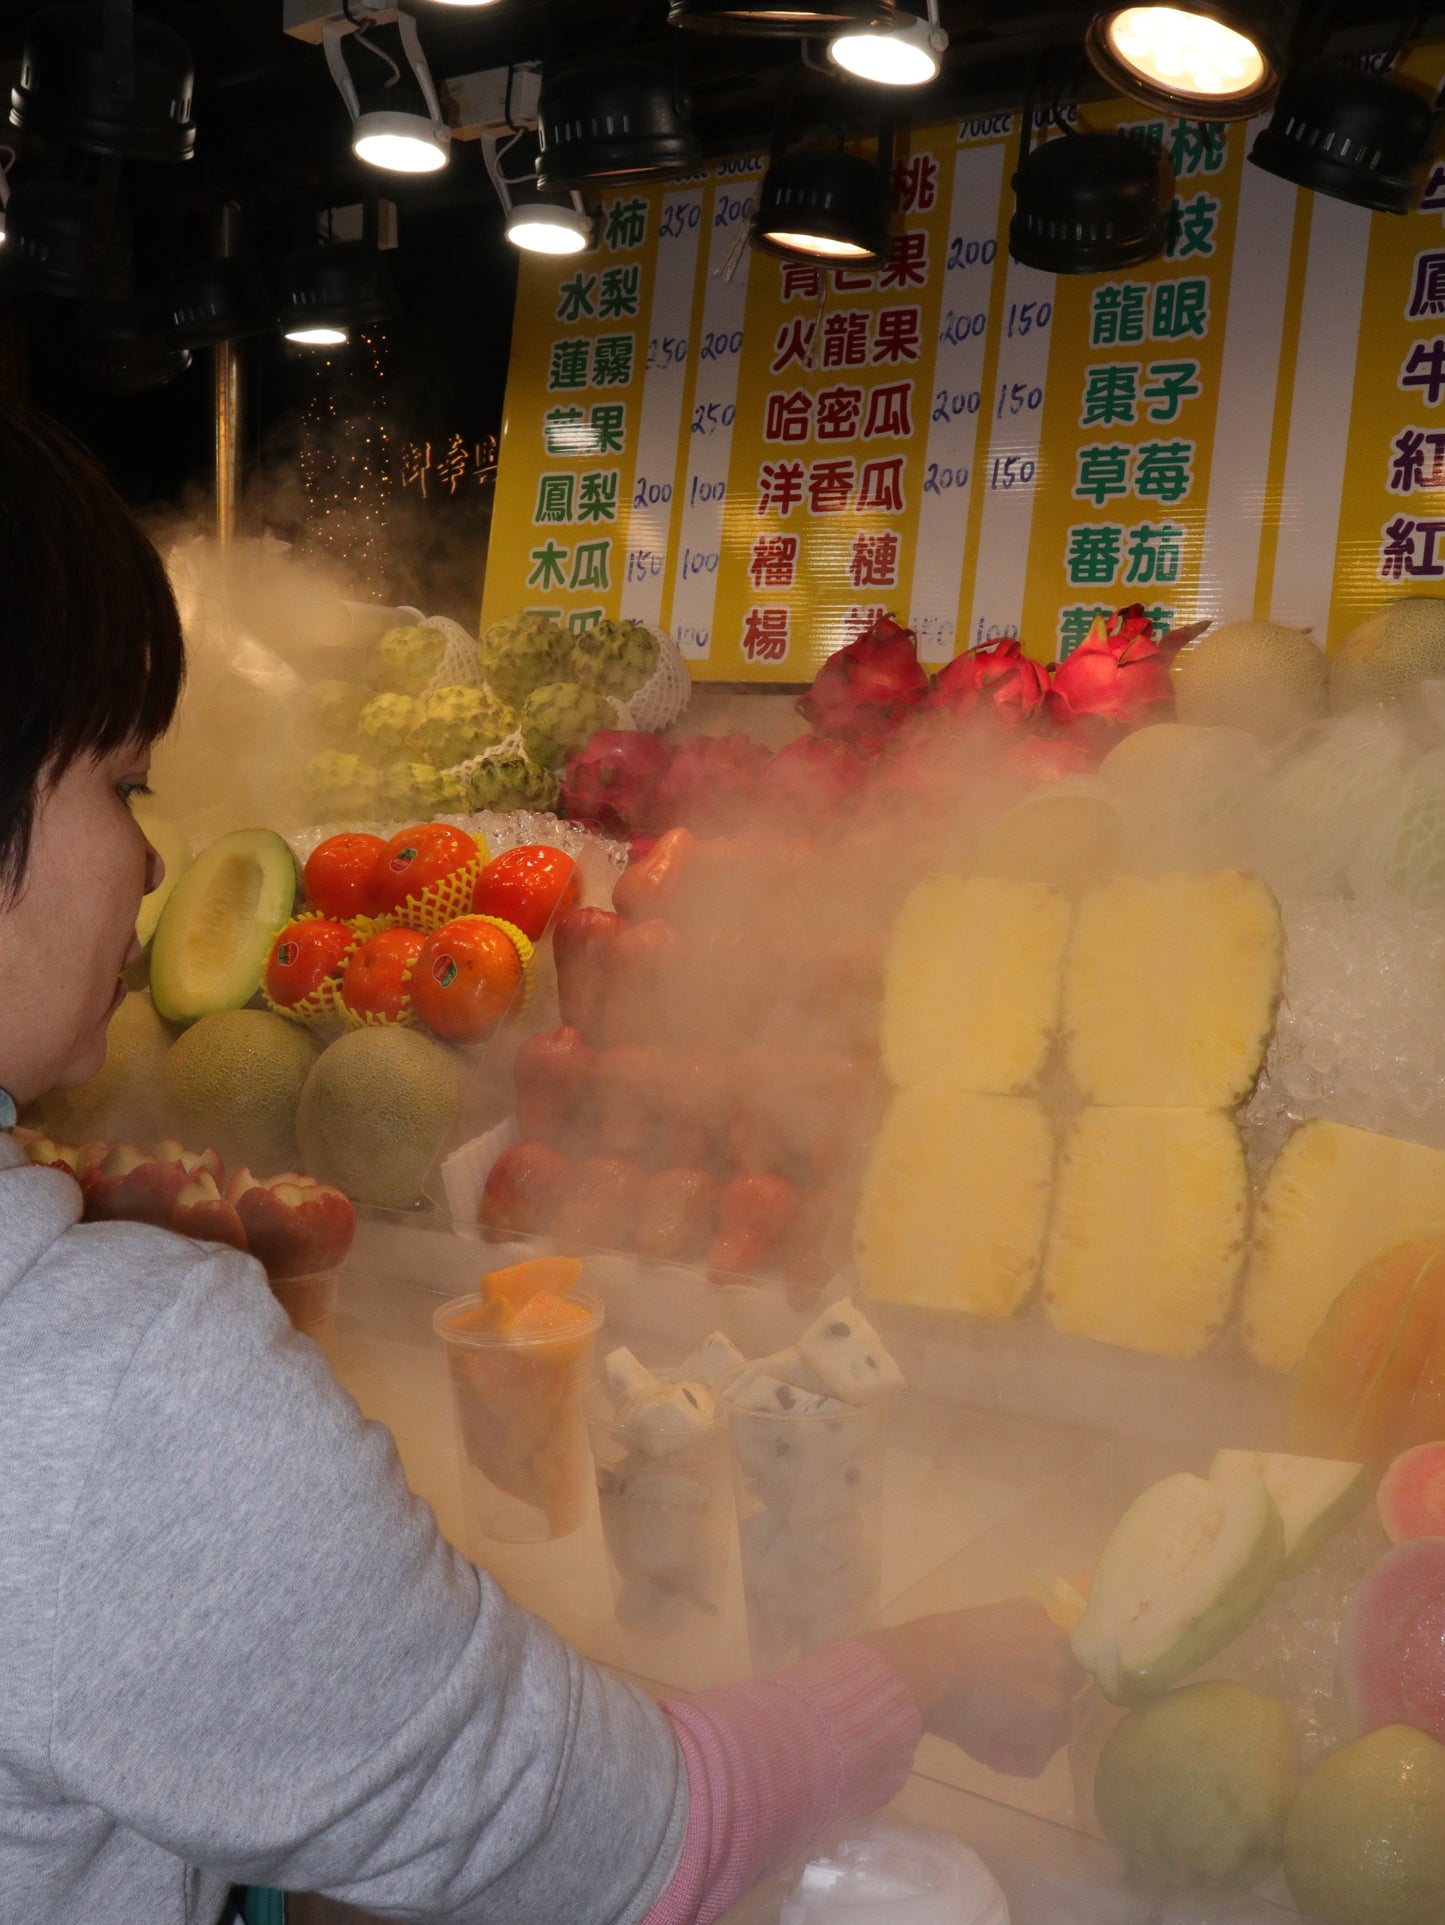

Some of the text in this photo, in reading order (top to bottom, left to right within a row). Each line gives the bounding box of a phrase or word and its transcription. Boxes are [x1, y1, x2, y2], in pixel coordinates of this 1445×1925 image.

[959, 114, 1012, 140] 700cc
[584, 197, 648, 251] 柿
[659, 203, 701, 239] 250
[947, 236, 998, 271] 200
[555, 264, 640, 322] 水梨
[1091, 279, 1208, 345] 龍眼
[939, 311, 986, 346] 200
[1006, 301, 1052, 339] 150
[700, 330, 744, 361] 200
[770, 307, 920, 372] 火龍果
[547, 334, 635, 390] 蓮霧
[765, 382, 912, 442] 哈密瓜
[932, 388, 982, 424] 200
[996, 383, 1044, 420] 150
[1081, 362, 1200, 425] 棗子
[691, 402, 737, 435] 250
[923, 462, 970, 496] 200
[990, 455, 1037, 491] 150
[1074, 442, 1192, 506] 草莓
[1390, 429, 1445, 492] 紅
[534, 471, 619, 523] 鳳梨
[633, 476, 673, 509] 200
[690, 475, 726, 509] 100
[756, 457, 904, 517] 洋香瓜
[527, 540, 611, 590] 木瓜
[626, 549, 664, 583] 150
[682, 547, 720, 581] 100
[1066, 524, 1184, 584] 蕃茄
[1380, 517, 1445, 580] 紅
